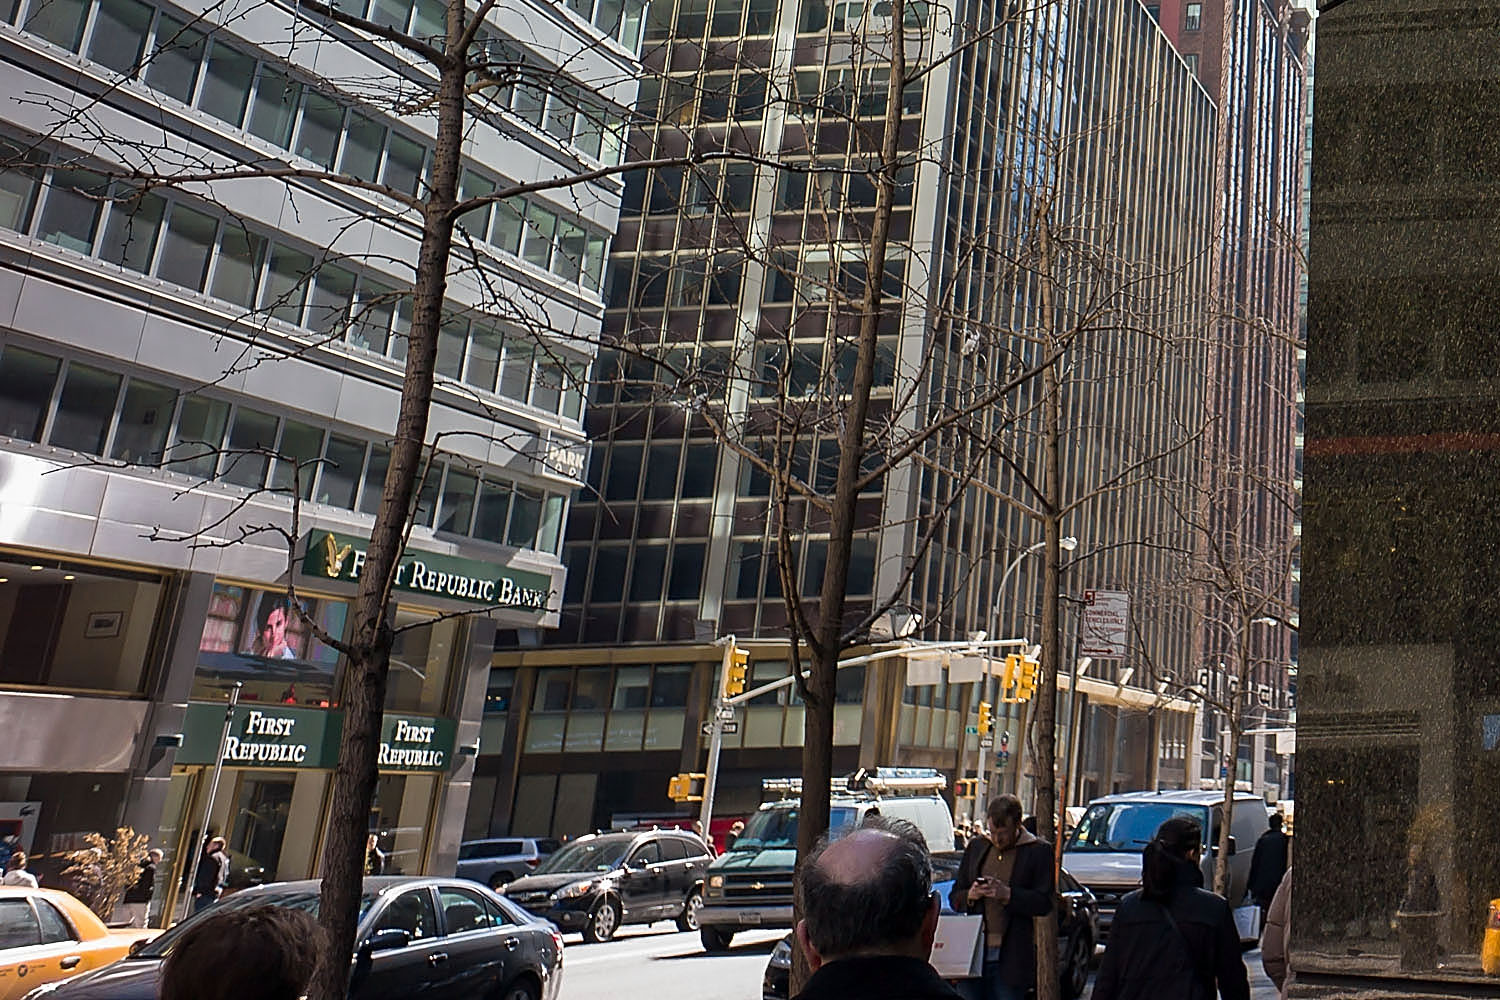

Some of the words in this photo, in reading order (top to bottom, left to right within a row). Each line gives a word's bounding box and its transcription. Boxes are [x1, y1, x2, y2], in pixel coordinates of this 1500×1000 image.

[549, 445, 585, 469] PARK
[410, 561, 495, 601] REPUBLIC
[499, 577, 542, 607] BANK
[246, 710, 295, 736] FIRST
[395, 720, 434, 743] FIRST
[223, 736, 307, 762] REPUBLIC
[378, 744, 444, 766] REPUBLIC
